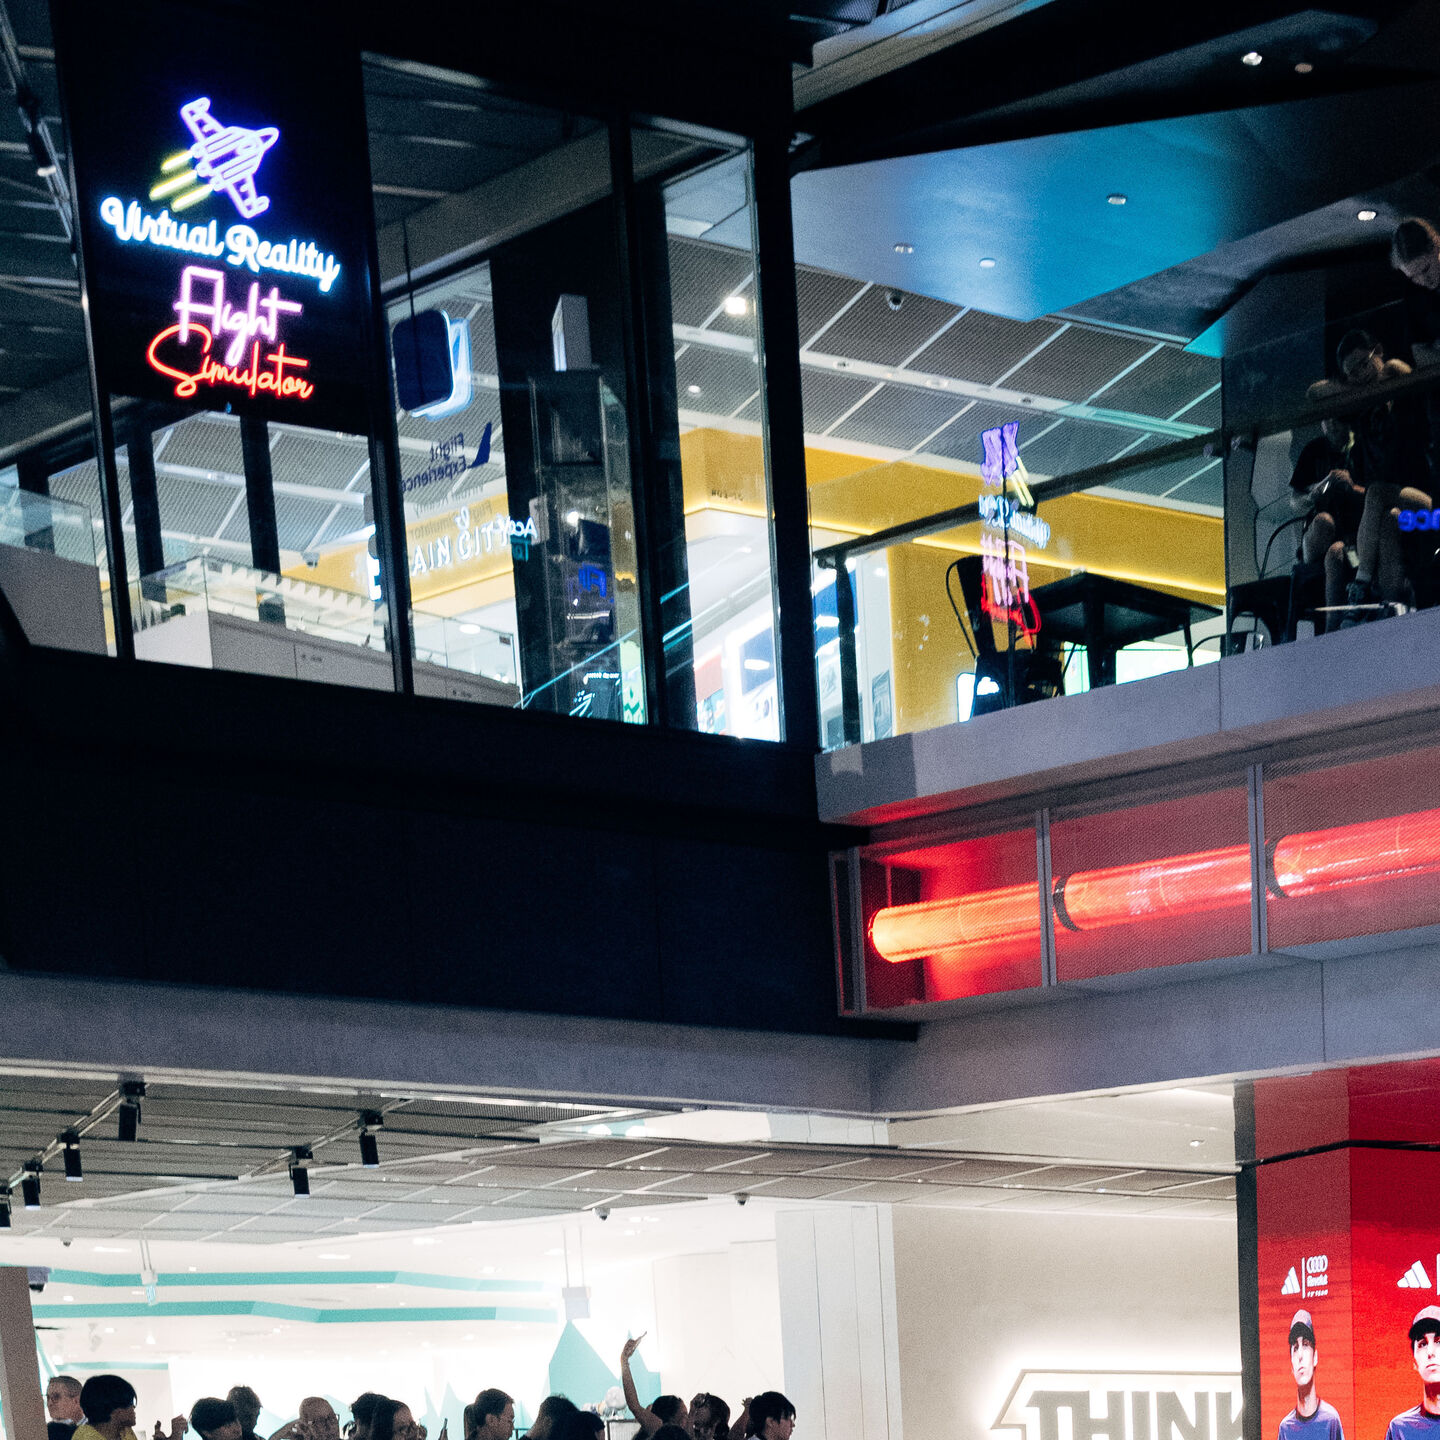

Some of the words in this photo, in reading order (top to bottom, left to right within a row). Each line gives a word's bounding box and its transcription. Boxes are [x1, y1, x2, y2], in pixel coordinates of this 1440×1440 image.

[99, 196, 226, 258] Virtual
[225, 223, 342, 293] Reality
[147, 321, 316, 400] Simulator
[172, 264, 304, 368] Flight
